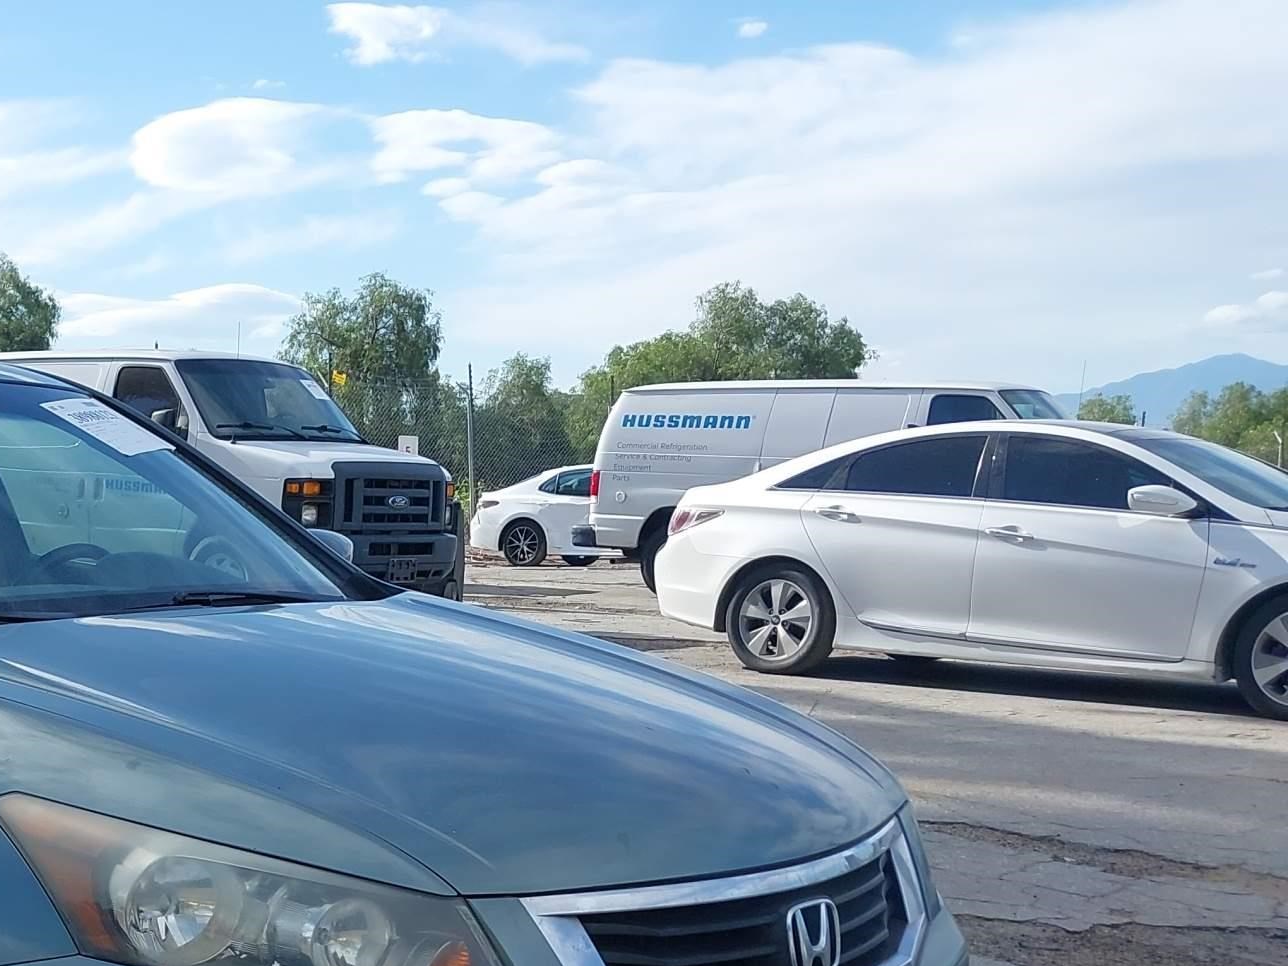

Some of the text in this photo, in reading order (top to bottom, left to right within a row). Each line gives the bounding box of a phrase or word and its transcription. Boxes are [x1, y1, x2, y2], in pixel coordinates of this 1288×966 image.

[621, 414, 751, 429] HUSSMANN
[616, 441, 709, 452] Commercial Refrigeration
[649, 454, 692, 462] Contracting
[613, 464, 652, 473] Equipment
[611, 474, 630, 482] Parts
